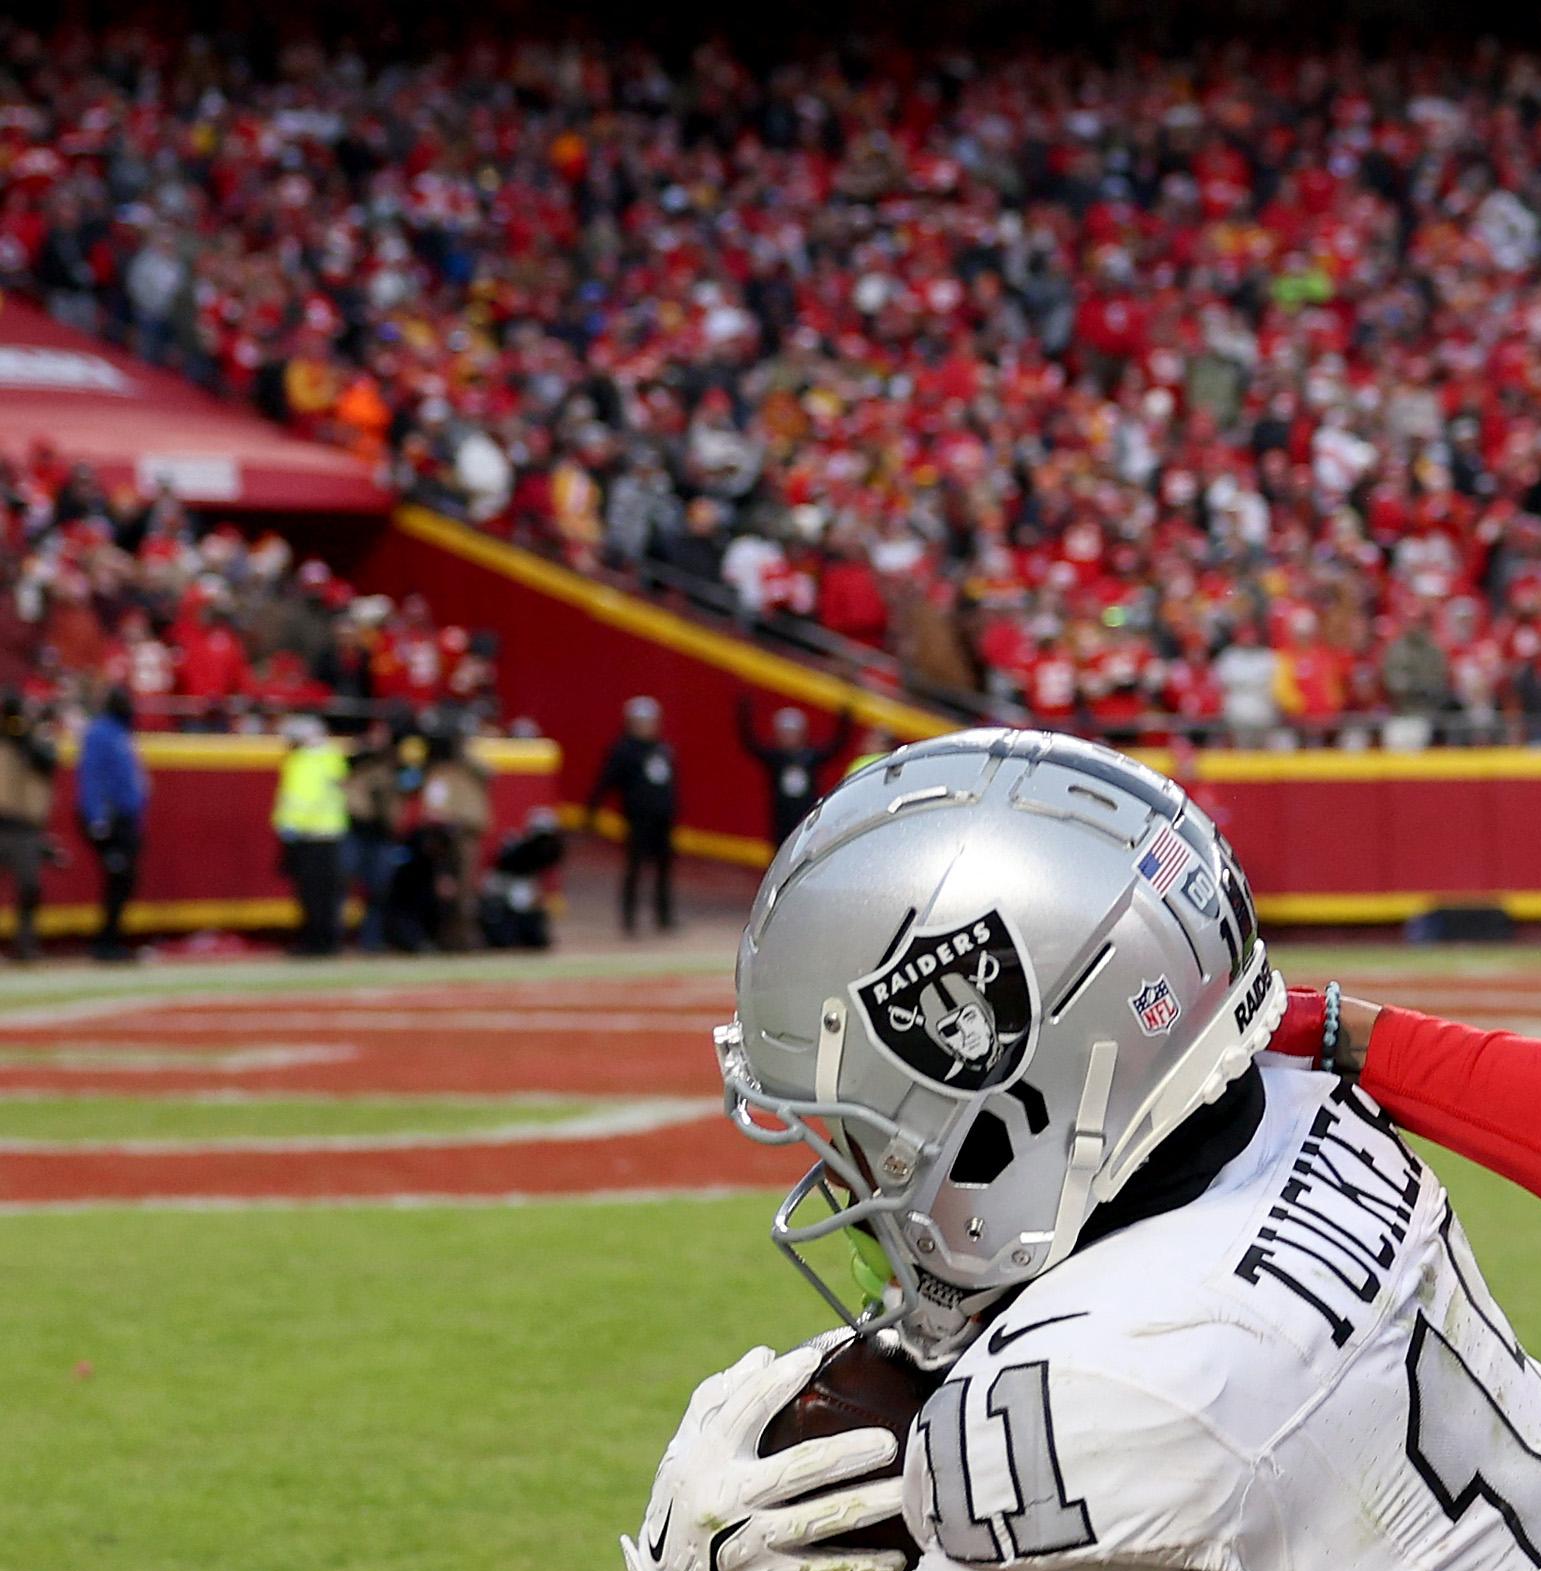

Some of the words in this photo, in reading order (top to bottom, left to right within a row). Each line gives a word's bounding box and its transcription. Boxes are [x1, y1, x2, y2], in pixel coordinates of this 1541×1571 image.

[872, 921, 991, 1005] RAIDERS
[1141, 997, 1179, 1031] NFL
[917, 1359, 1098, 1563] 11
